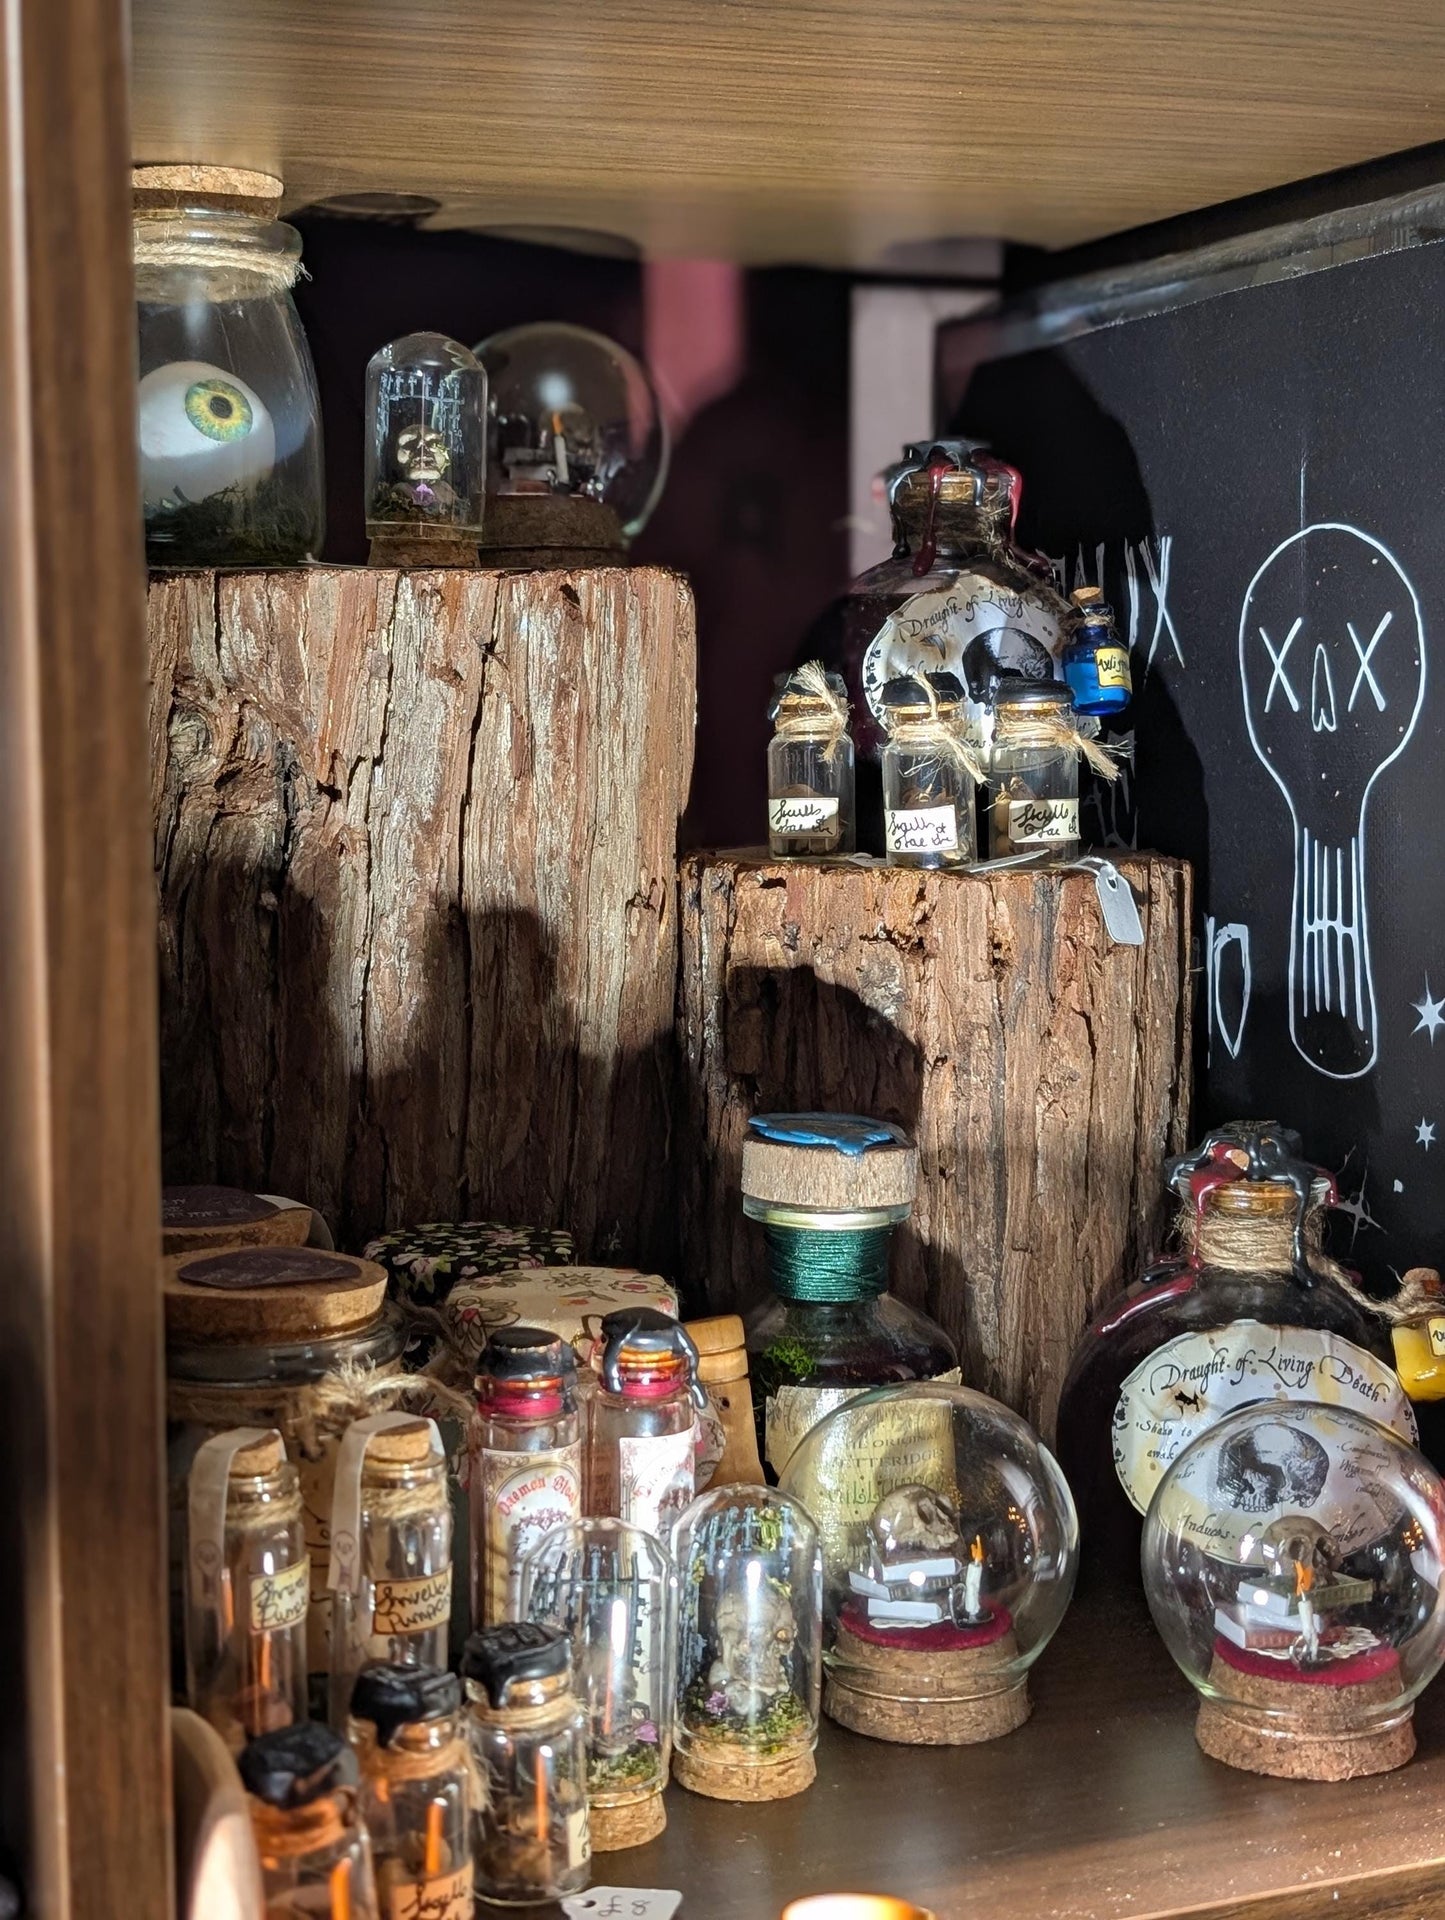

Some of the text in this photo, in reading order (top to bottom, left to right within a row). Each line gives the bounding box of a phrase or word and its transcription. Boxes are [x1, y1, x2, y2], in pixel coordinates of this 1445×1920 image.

[964, 594, 979, 623] of
[1150, 1346, 1391, 1402] Draught of Living Death
[498, 1476, 547, 1517] Daemon
[599, 1895, 653, 1917] £8
